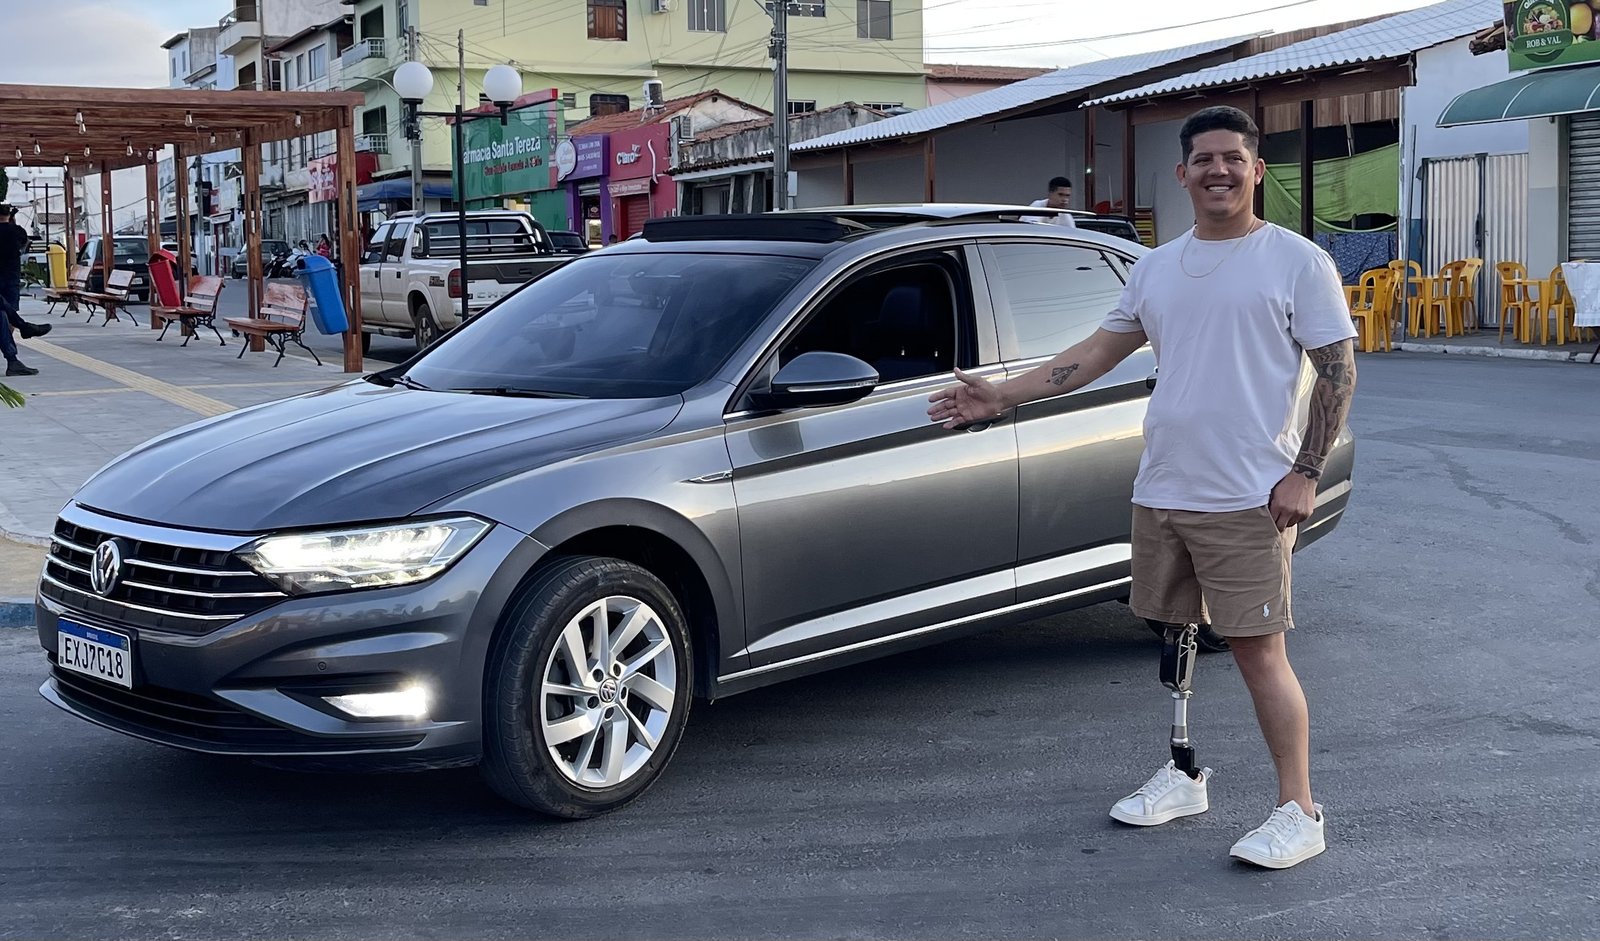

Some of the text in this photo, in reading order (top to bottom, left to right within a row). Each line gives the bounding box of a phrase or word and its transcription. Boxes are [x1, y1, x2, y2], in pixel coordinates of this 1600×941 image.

[1526, 36, 1562, 49] ROB & VAL
[491, 139, 514, 159] Santa
[515, 136, 541, 154] Tereza
[616, 151, 635, 165] Claro
[64, 637, 124, 679] EXJ7C18
